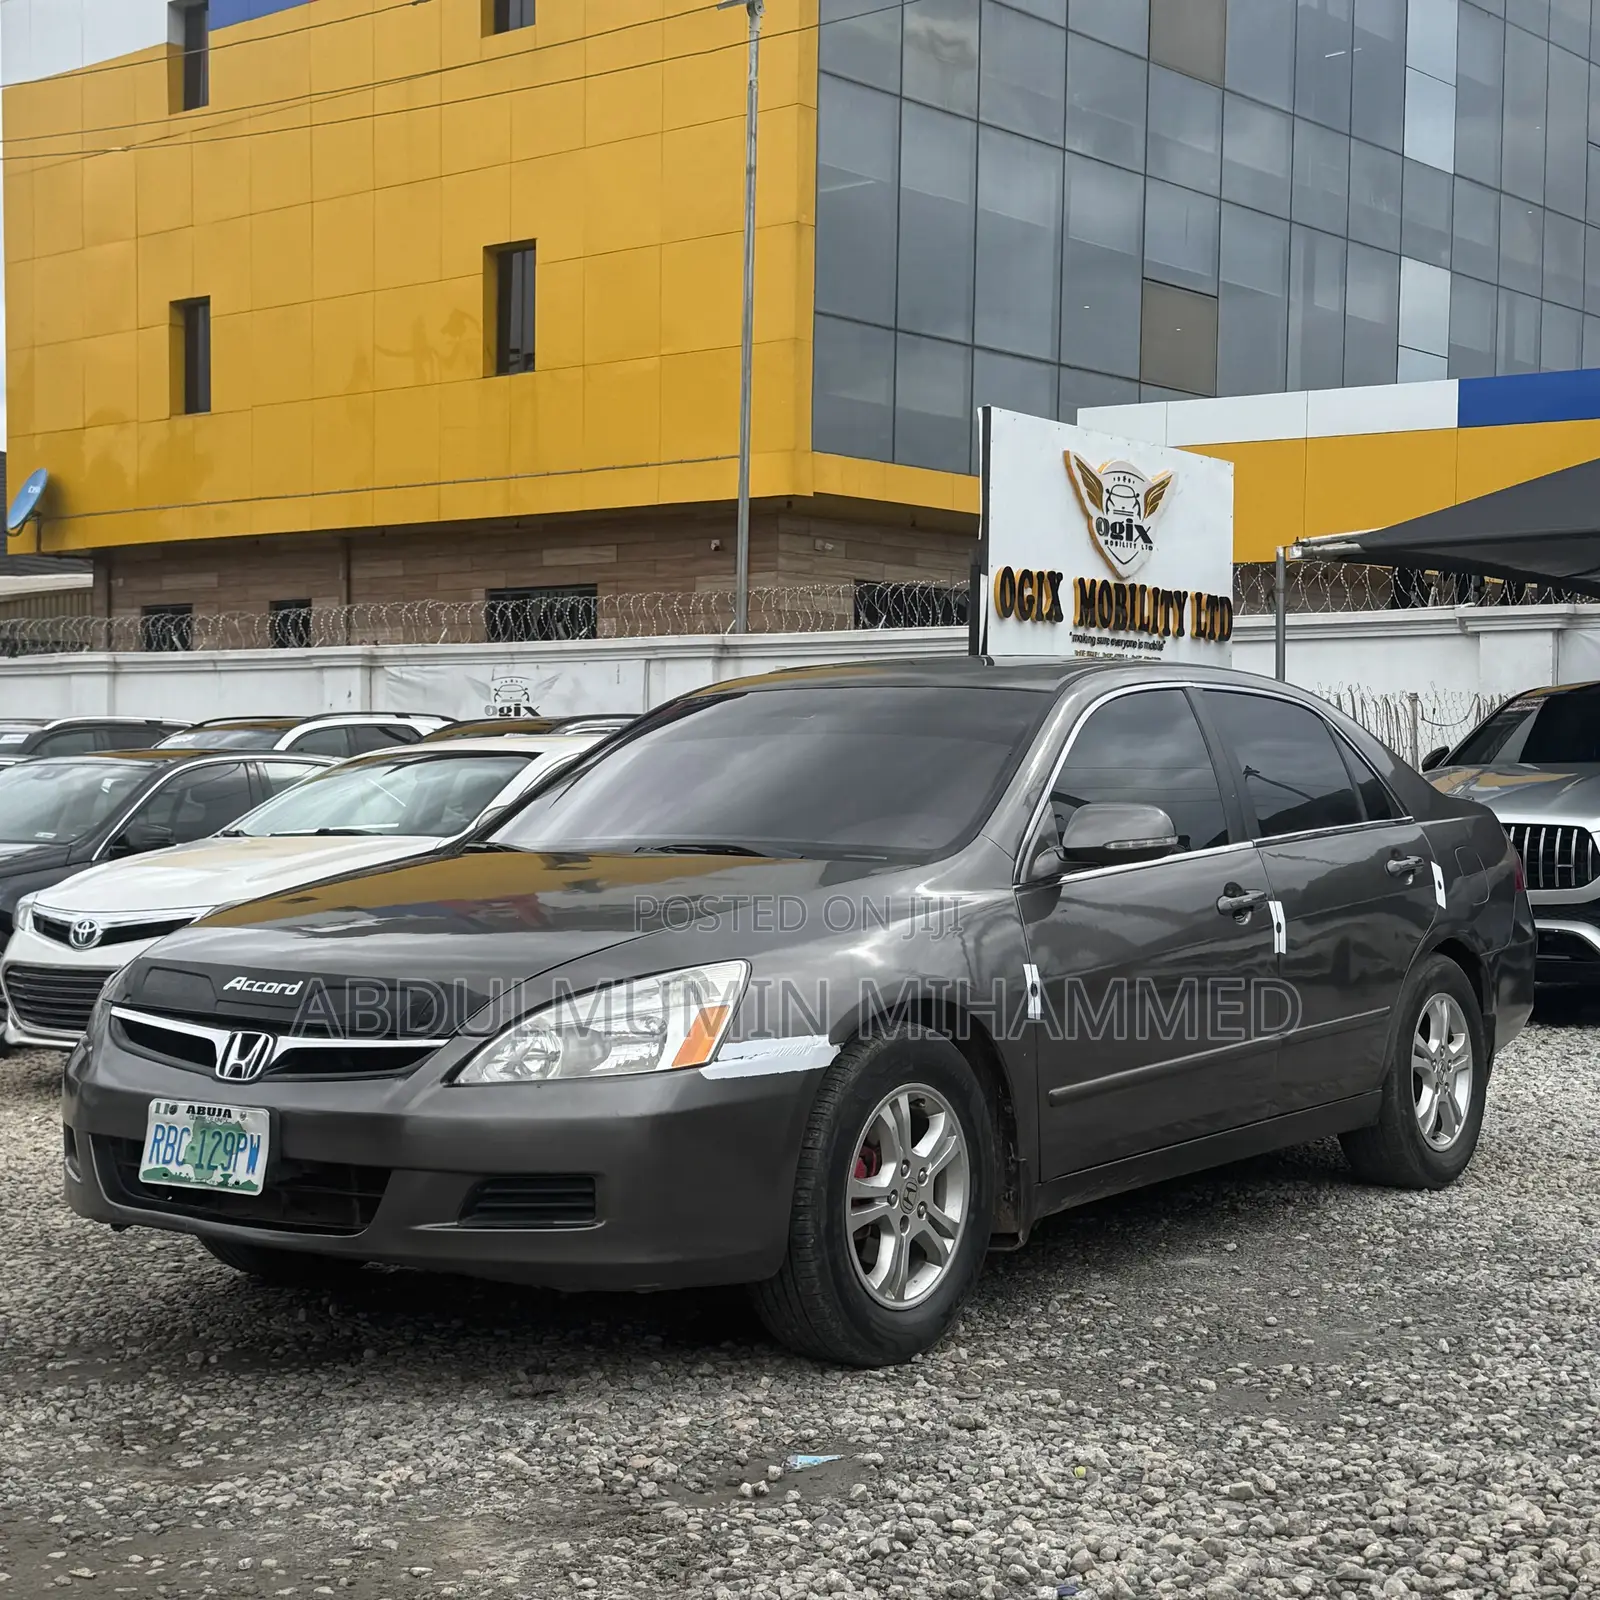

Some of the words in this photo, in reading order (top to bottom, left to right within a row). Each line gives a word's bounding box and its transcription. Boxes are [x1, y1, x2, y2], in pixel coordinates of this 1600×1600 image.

[1104, 539, 1137, 550] MOBILITY
[994, 566, 1064, 623] OGIX
[1073, 577, 1189, 637] MOBILITY
[1190, 591, 1233, 642] LTD
[222, 976, 304, 996] Accord
[185, 1104, 233, 1119] ABUJA
